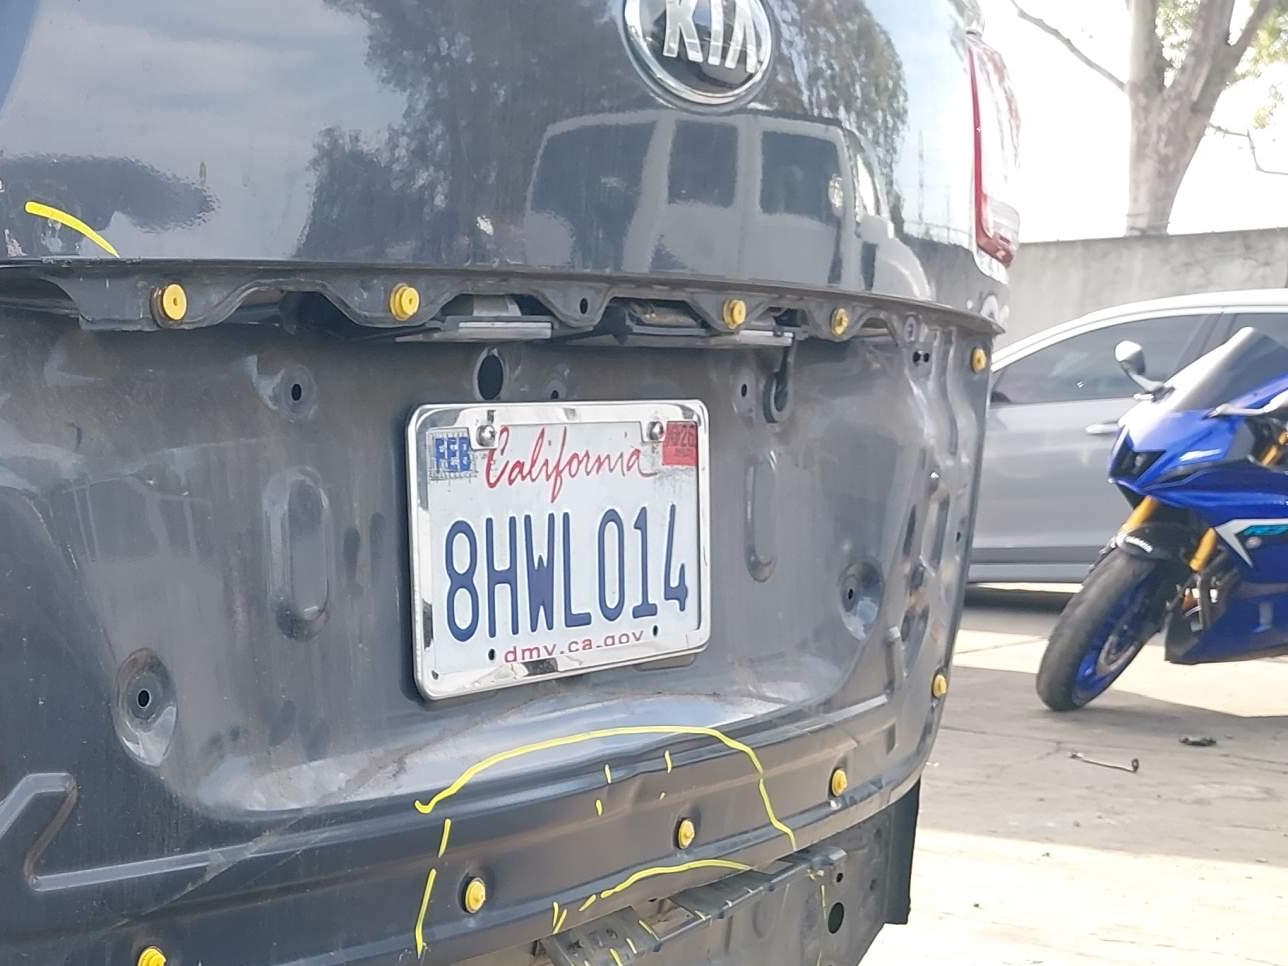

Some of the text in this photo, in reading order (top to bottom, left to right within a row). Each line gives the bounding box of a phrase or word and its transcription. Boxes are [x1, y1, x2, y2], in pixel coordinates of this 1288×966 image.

[663, 0, 757, 73] KIA
[435, 436, 472, 473] FEB
[485, 425, 658, 503] California
[445, 504, 688, 642] 8HWL014
[504, 630, 644, 663] dmv.ca.gov
